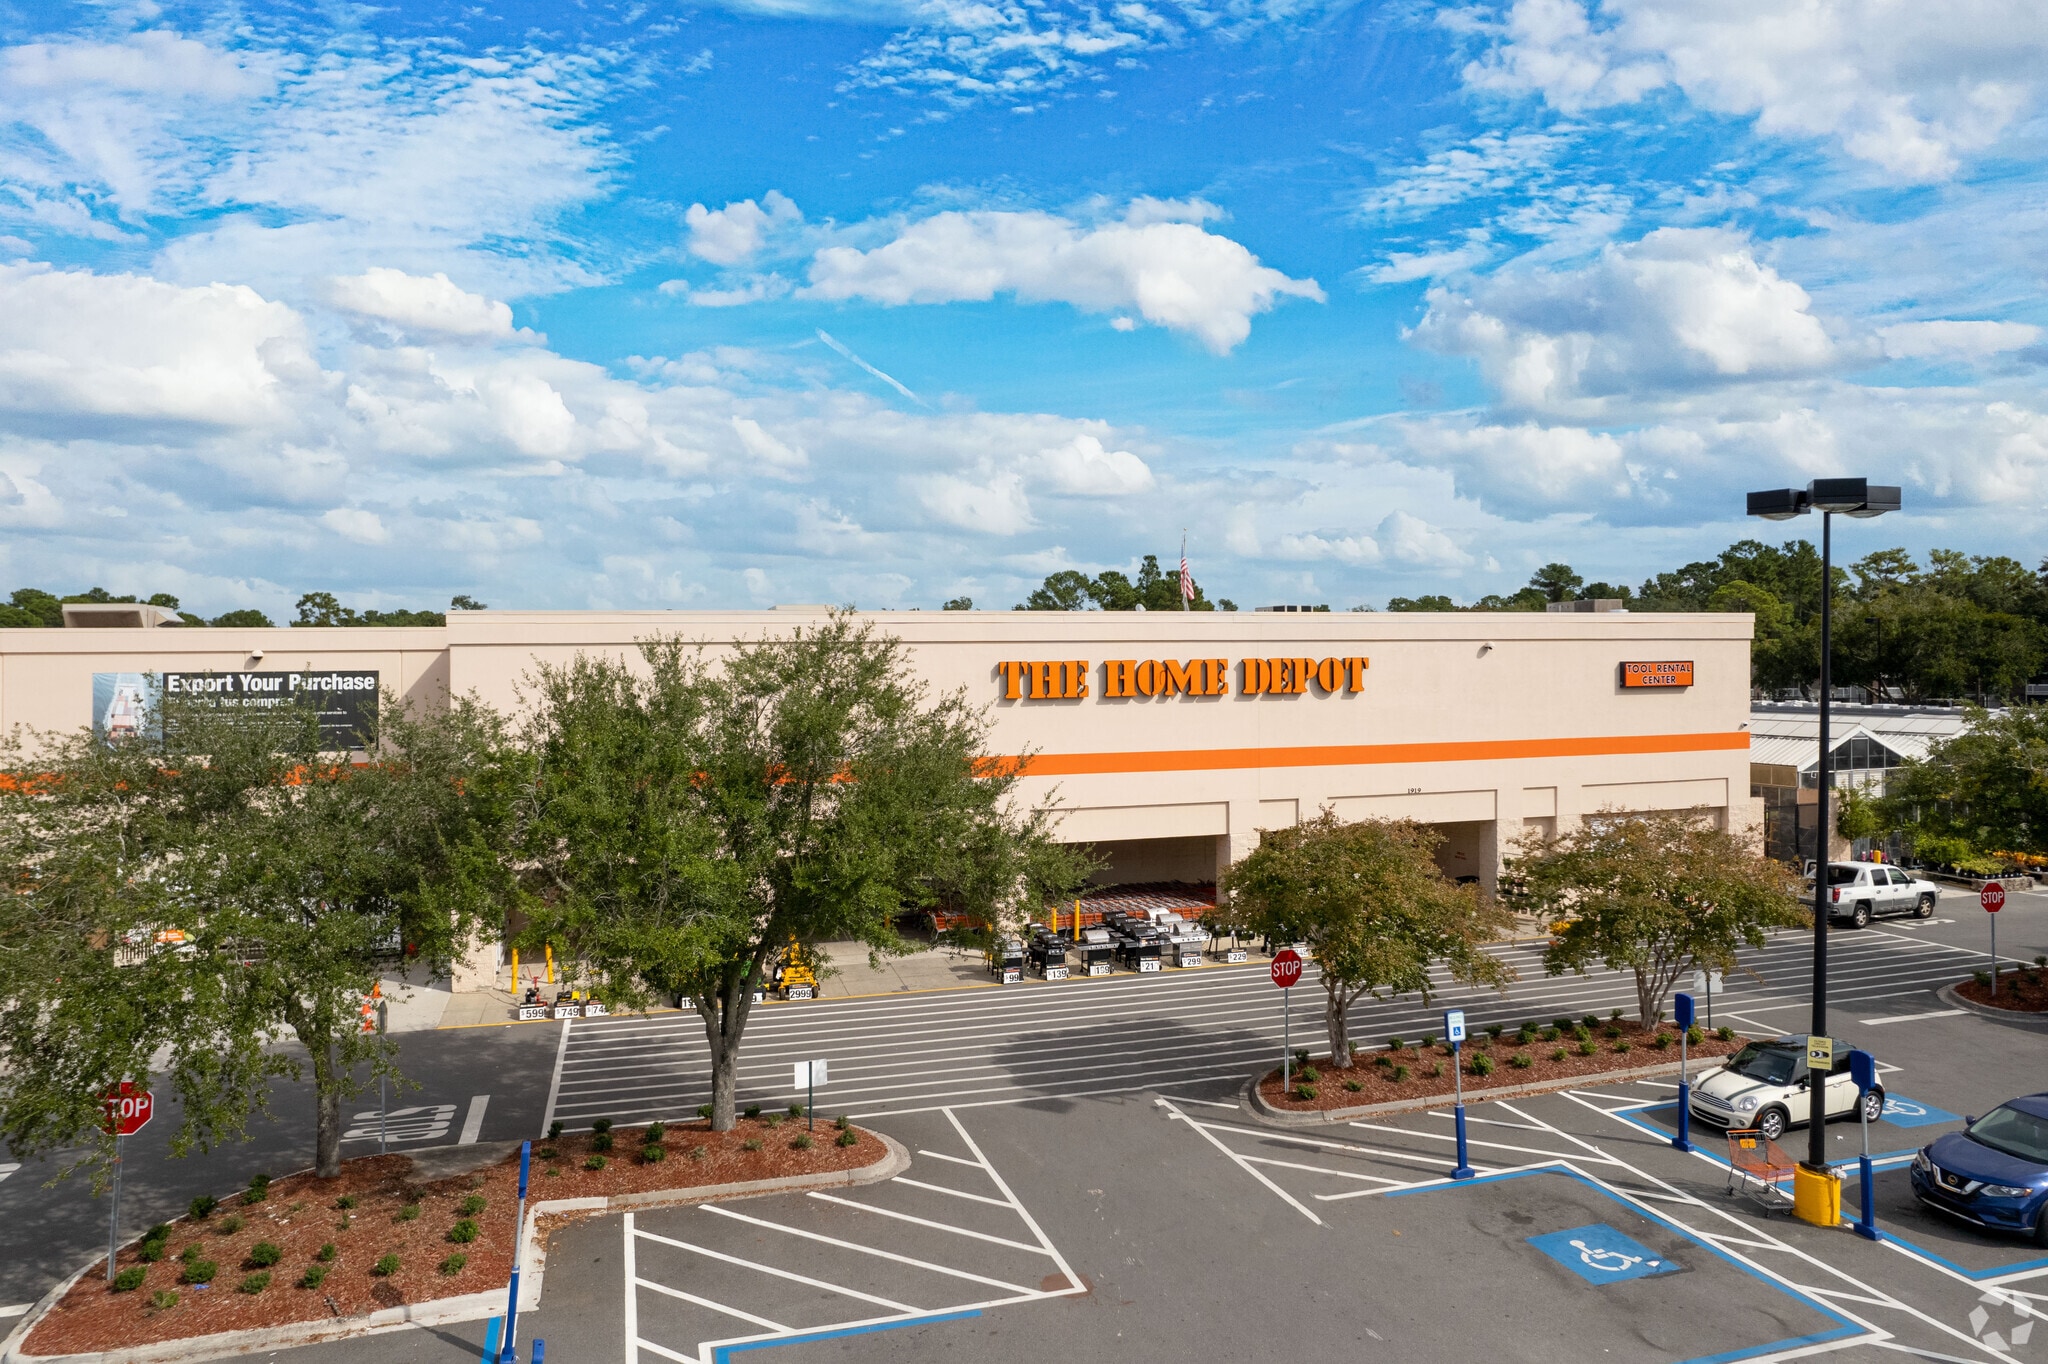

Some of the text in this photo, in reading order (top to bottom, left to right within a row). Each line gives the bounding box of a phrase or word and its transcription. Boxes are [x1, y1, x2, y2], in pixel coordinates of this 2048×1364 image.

[1627, 664, 1691, 673] TOOL RENTAL
[168, 673, 375, 695] Export Your Purchase
[1000, 657, 1370, 699] THE HOME DEPOT
[1642, 675, 1676, 684] CENTER
[1982, 891, 2004, 904] STOP
[1273, 960, 1301, 978] STOP
[790, 989, 812, 999] 2999
